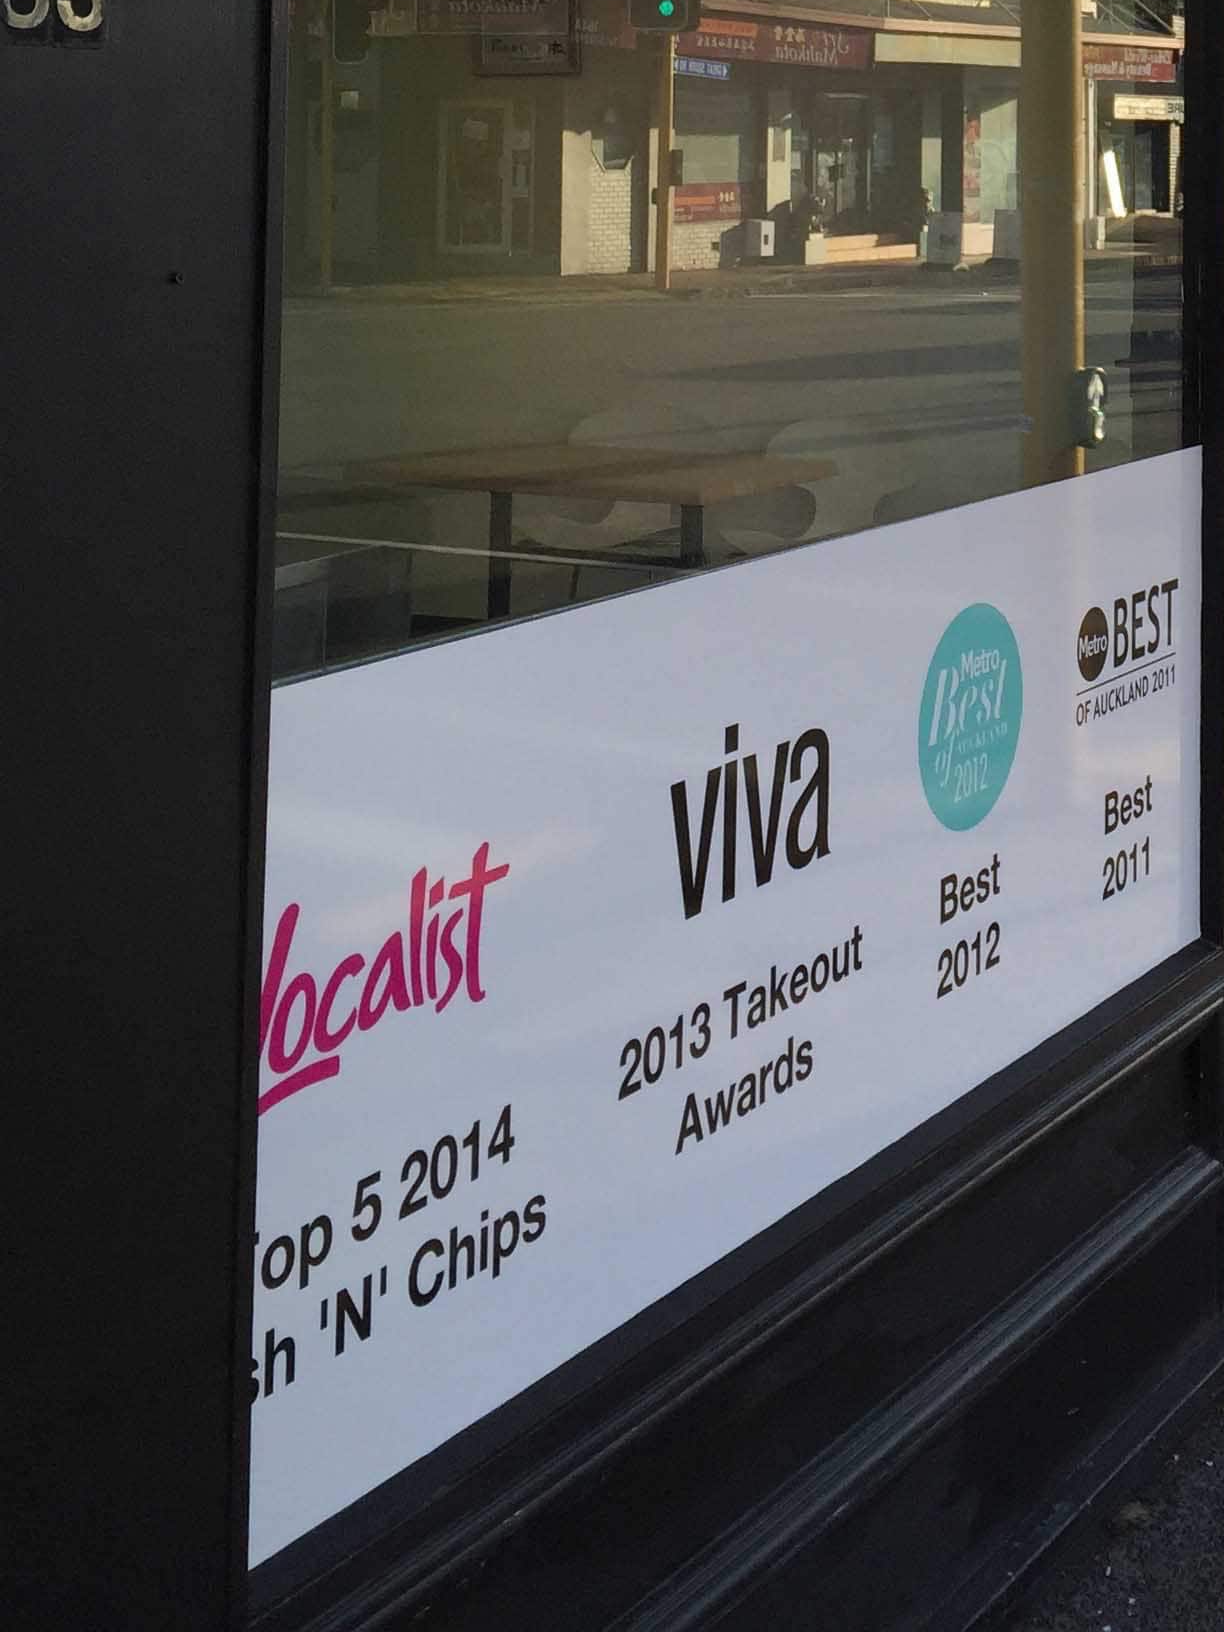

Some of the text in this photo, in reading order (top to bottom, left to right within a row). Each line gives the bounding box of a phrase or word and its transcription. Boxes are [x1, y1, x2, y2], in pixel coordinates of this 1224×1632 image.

[960, 648, 999, 682] Metro
[1078, 578, 1179, 669] Metro BEST
[928, 658, 1008, 747] Best
[1076, 665, 1176, 726] OF AUCKLAND 2011
[954, 753, 989, 804] 2012
[1104, 774, 1153, 835] Best
[670, 723, 832, 921] viva
[940, 853, 1001, 925] Best
[1102, 836, 1150, 901] 2011
[937, 921, 1000, 1000] 2012
[617, 925, 863, 1101] 2013 Takeout
[675, 1035, 813, 1155] Awards
[254, 1104, 515, 1290] op 5 2014
[407, 1194, 547, 1308] Chips
